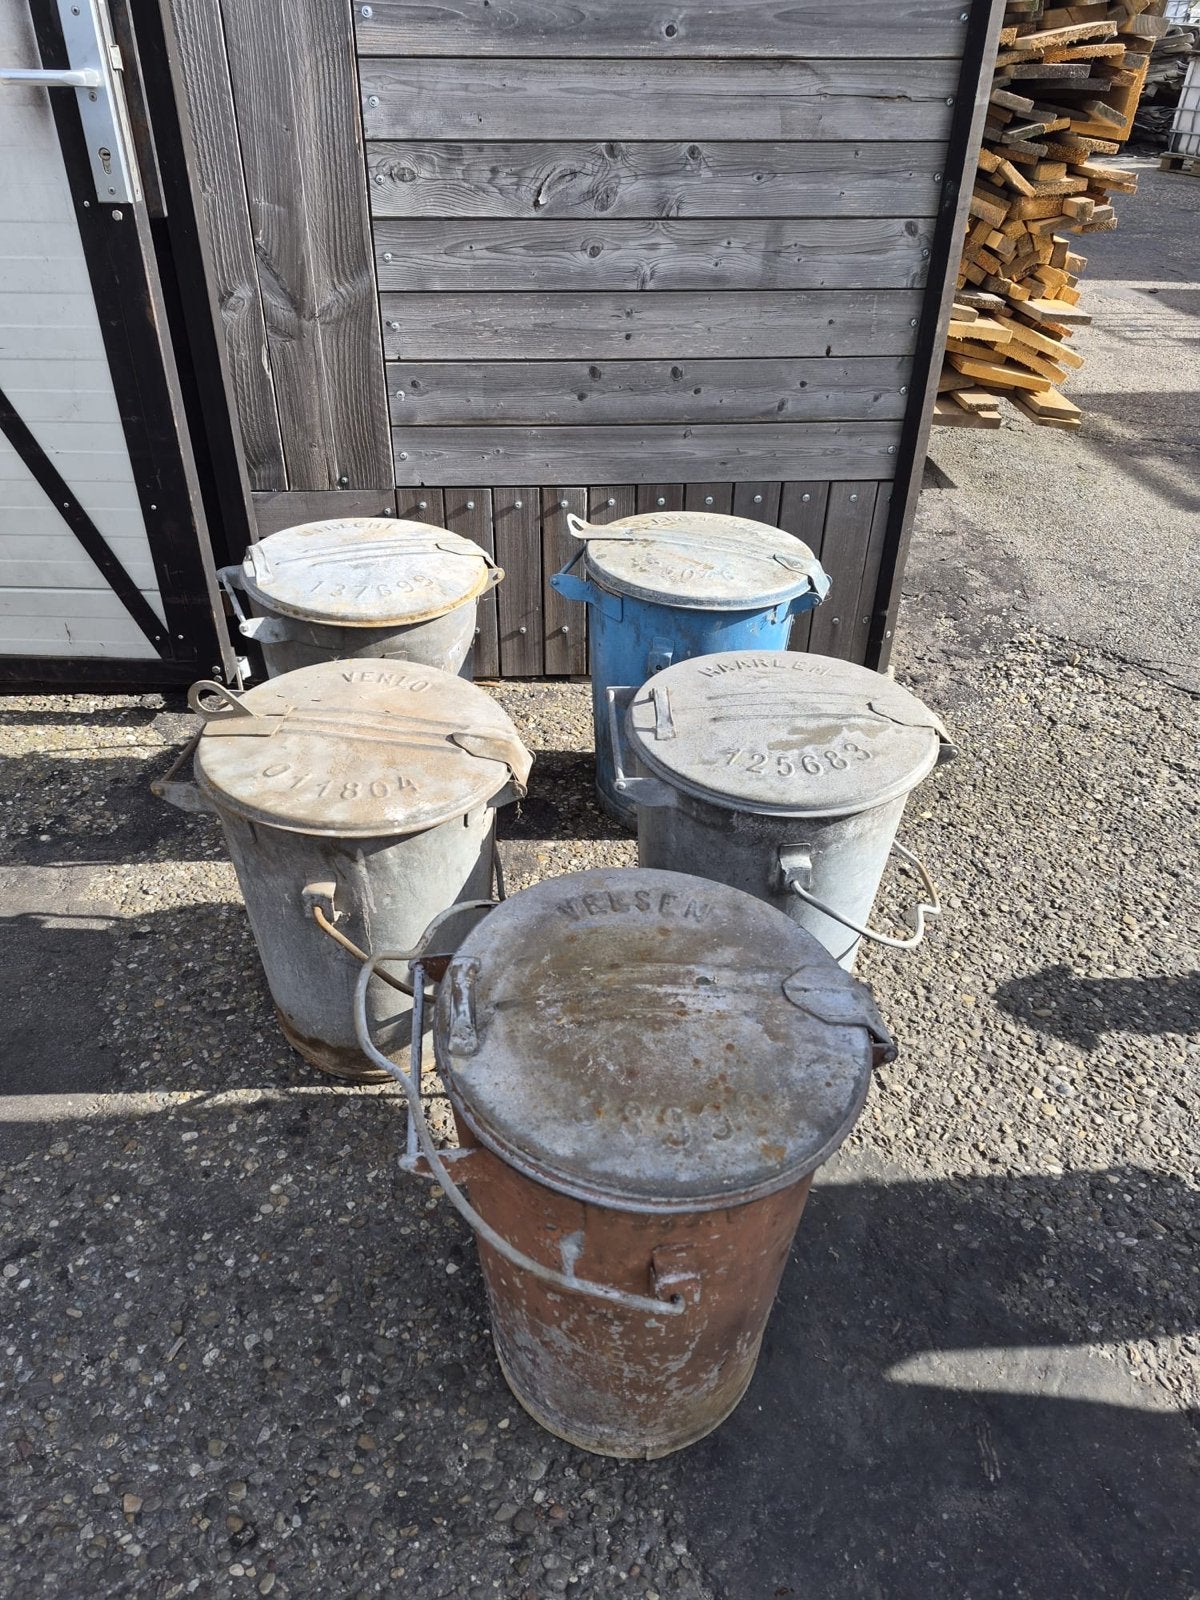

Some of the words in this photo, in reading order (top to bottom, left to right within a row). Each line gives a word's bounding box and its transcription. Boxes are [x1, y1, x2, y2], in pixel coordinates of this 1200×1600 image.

[340, 670, 433, 694] VENLO
[697, 657, 832, 679] HAARLEM
[724, 742, 873, 778] 125683
[262, 762, 421, 801] 011804
[554, 886, 714, 924] VELSEN
